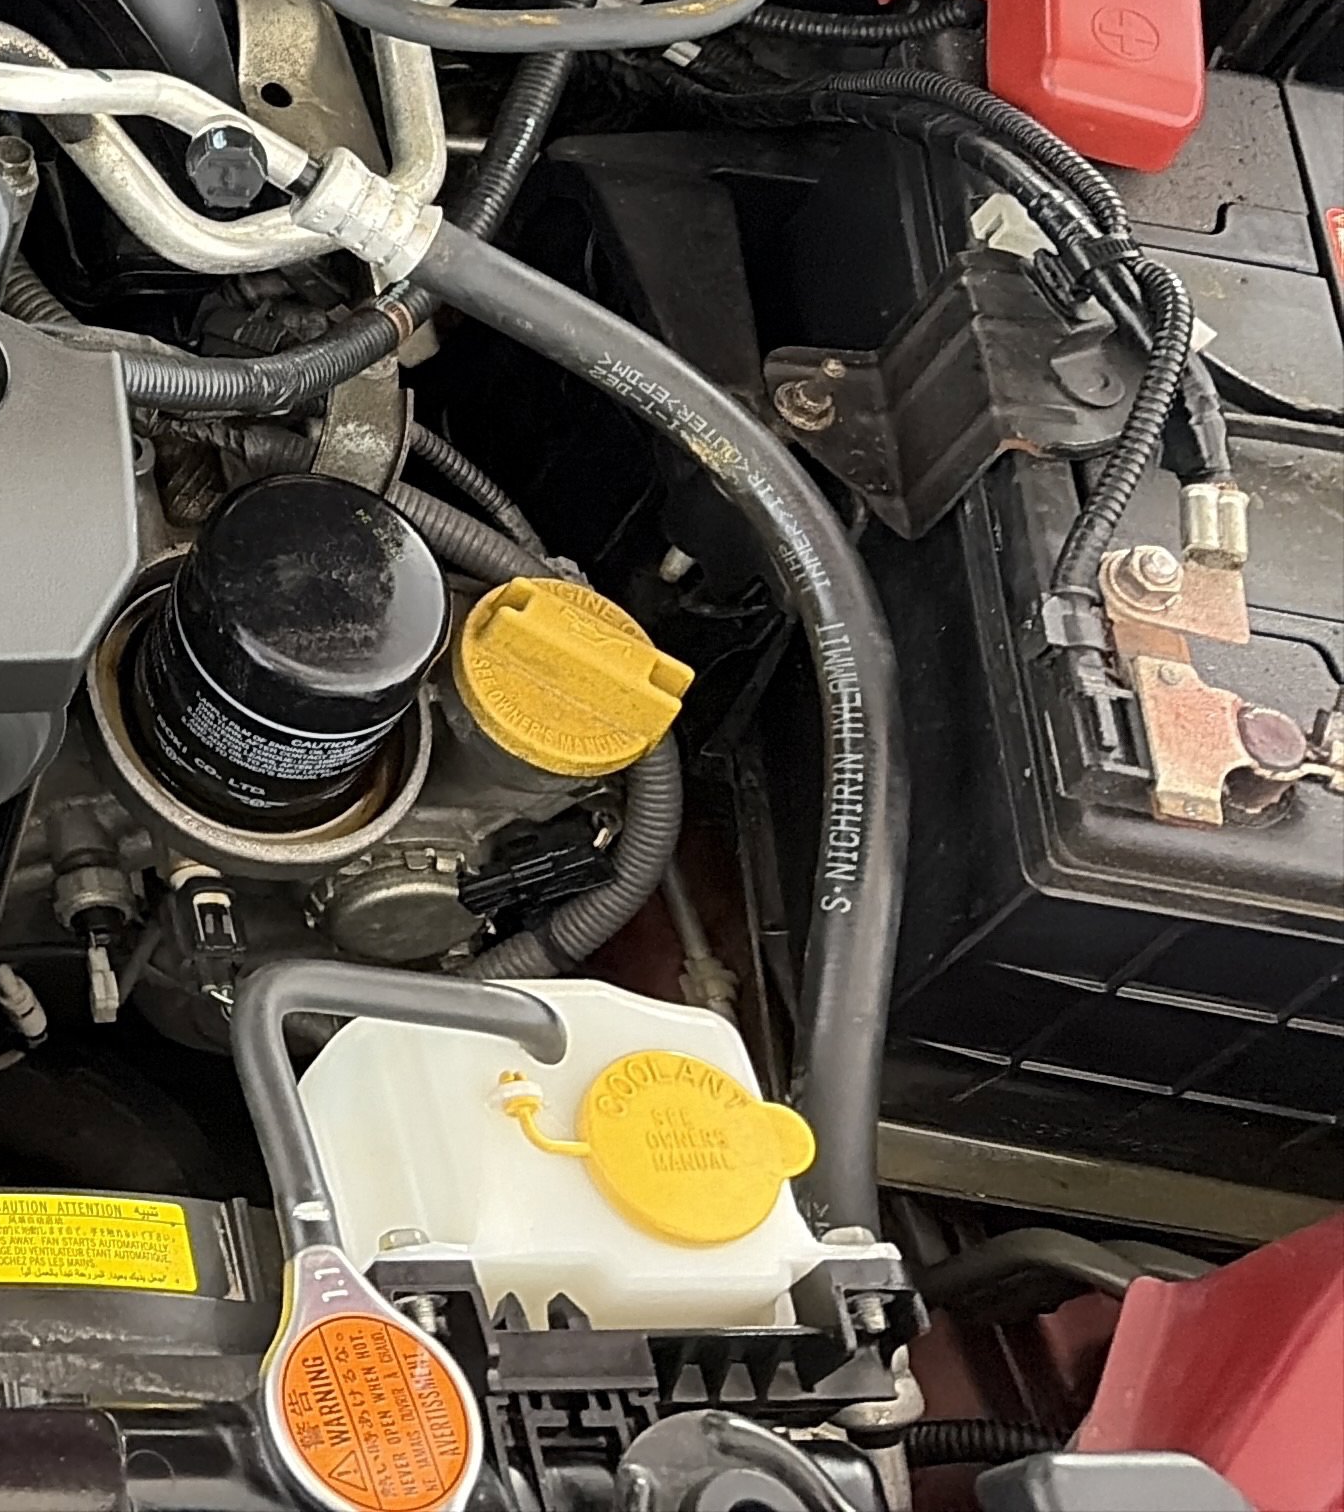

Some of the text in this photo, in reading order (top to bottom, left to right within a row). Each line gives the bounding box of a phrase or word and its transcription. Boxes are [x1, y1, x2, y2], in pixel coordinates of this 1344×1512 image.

[548, 583, 617, 620] GINE
[473, 654, 496, 690] SEE
[488, 689, 554, 745] OWNER'S
[291, 739, 357, 749] CAUTION
[596, 1058, 749, 1118] COOLANT
[652, 1153, 736, 1173] MANUAL
[57, 1201, 122, 1217] ATTENTION
[14, 1247, 27, 1256] DU
[28, 1248, 85, 1257] VENTILATEUR
[41, 1237, 59, 1246] FAN
[62, 1238, 96, 1247] STARTS
[29, 1257, 46, 1266] PAS
[48, 1257, 65, 1266] LES
[313, 1267, 349, 1303] 1.1
[302, 1355, 352, 1447] WARNING
[350, 1330, 418, 1496] NEVER OPEN WHEN HOT.
